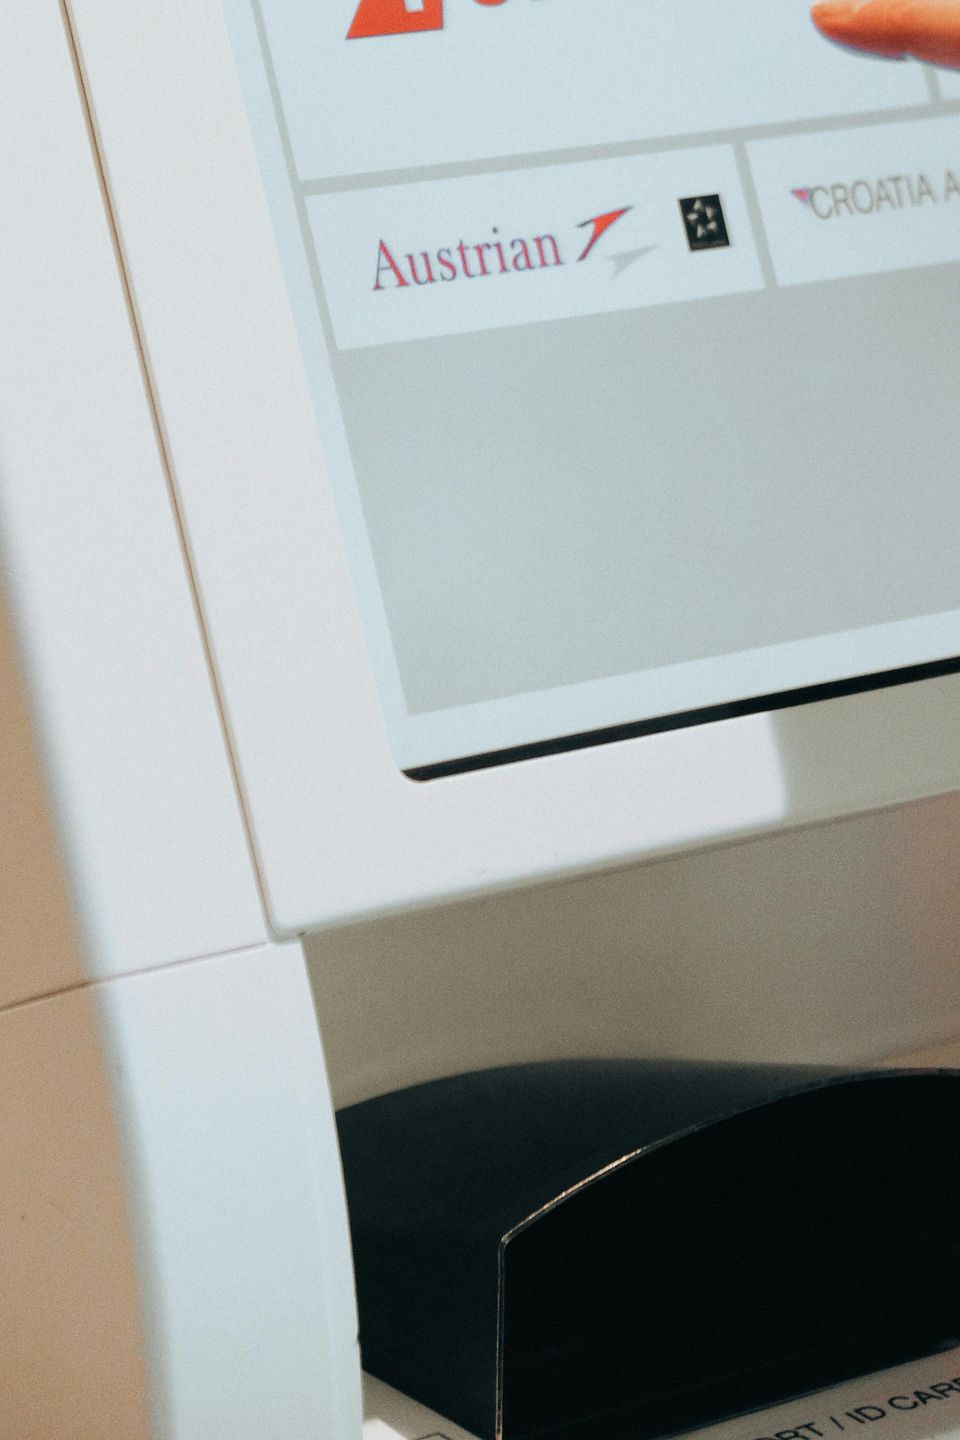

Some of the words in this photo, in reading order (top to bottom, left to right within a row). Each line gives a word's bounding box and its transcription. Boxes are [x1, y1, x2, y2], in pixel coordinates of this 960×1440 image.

[810, 173, 936, 220] CROATIA
[373, 227, 565, 291] Austrian
[845, 1404, 887, 1425] ID
